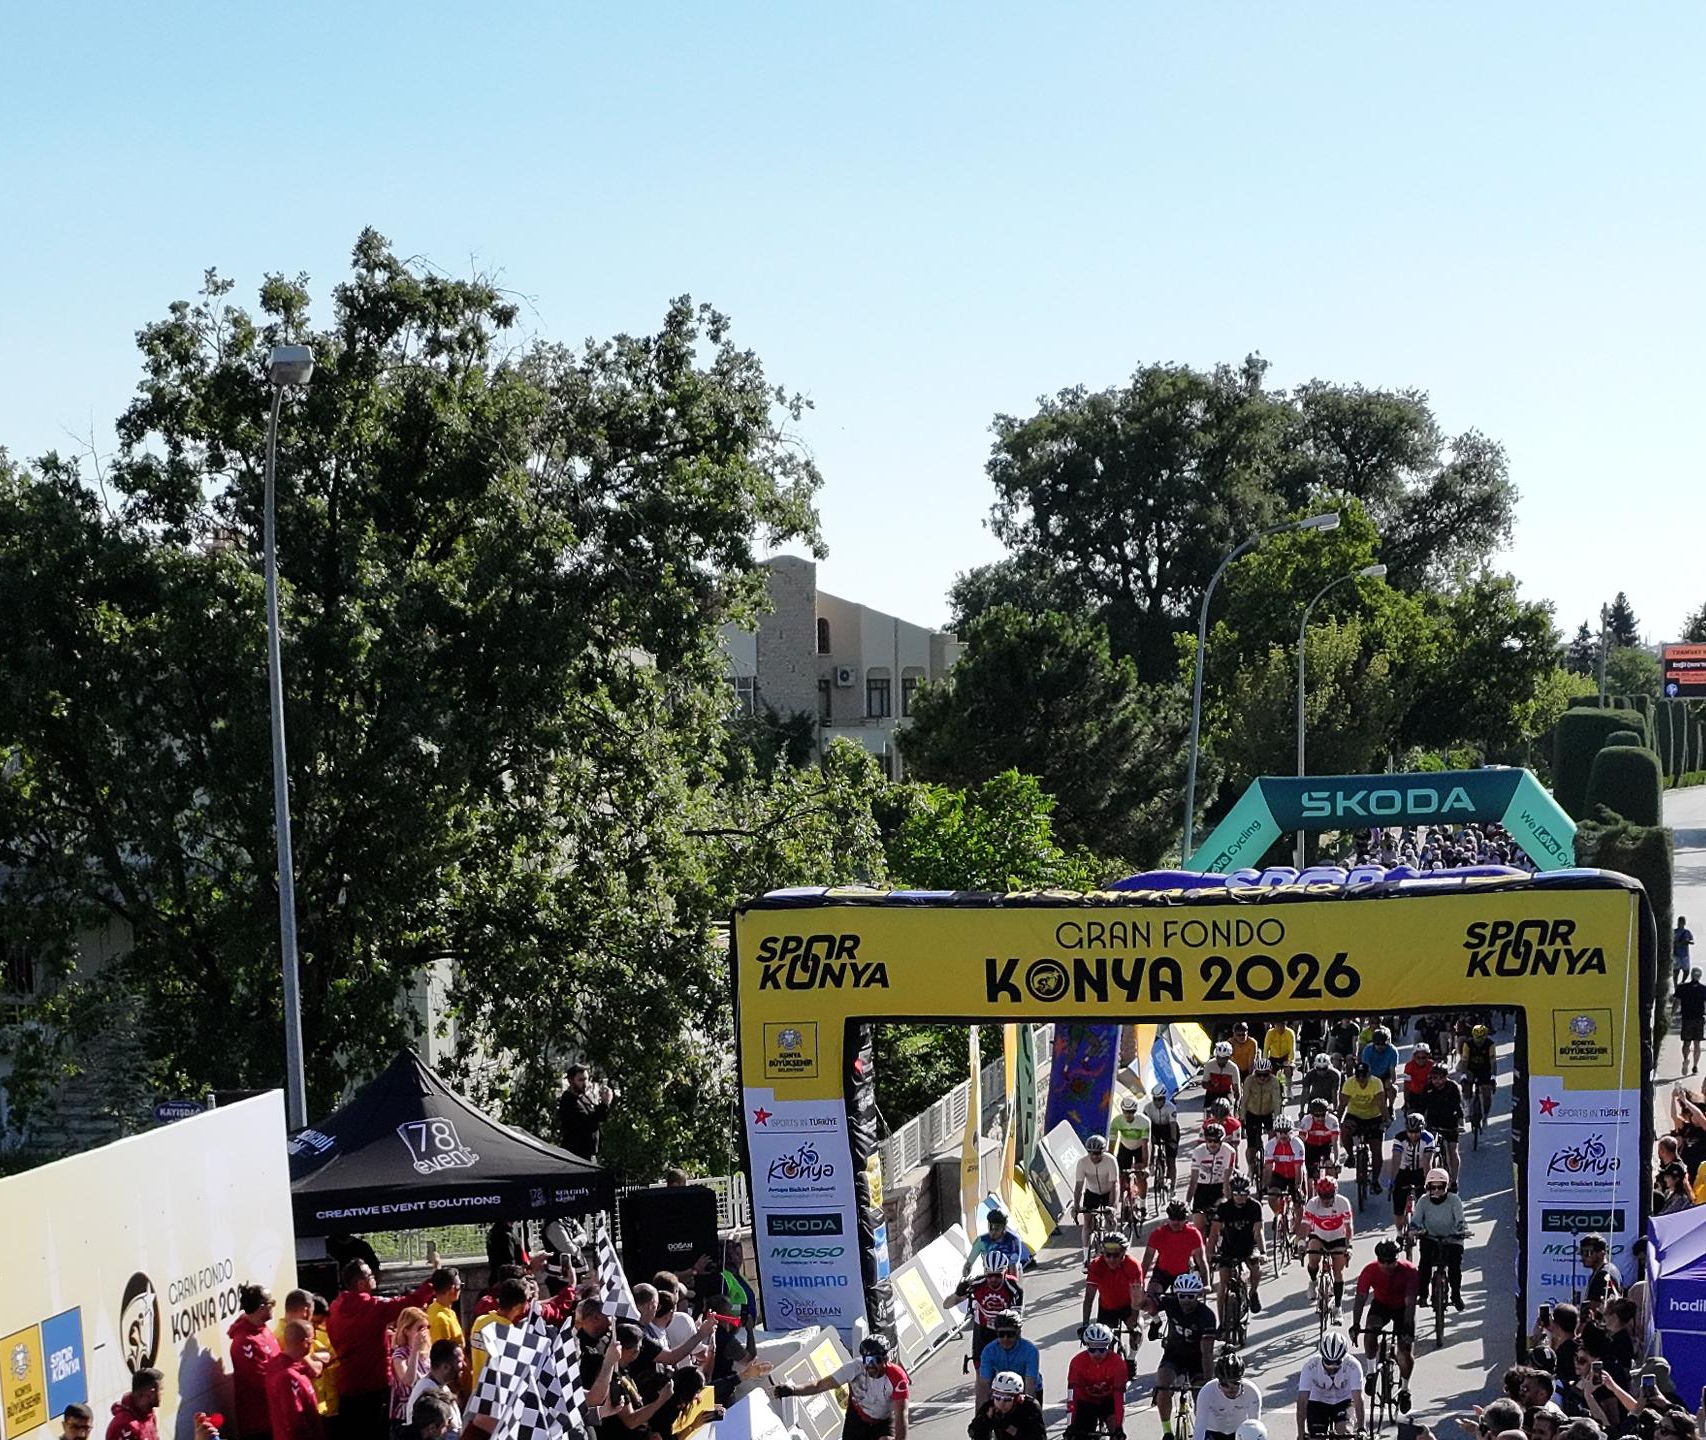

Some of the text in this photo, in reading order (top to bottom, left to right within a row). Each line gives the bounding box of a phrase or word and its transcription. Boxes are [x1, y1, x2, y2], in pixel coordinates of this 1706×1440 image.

[1227, 820, 1261, 855] Cycling
[757, 934, 861, 962] SPOR
[1056, 918, 1285, 950] GRAN FONDO
[1463, 920, 1576, 949] SPOR
[759, 961, 890, 991] KONYA
[1465, 948, 1606, 977] KONYA
[985, 952, 1362, 1003] KONYA 2026
[408, 1122, 456, 1153] 78
[414, 1147, 479, 1173] event
[316, 1195, 501, 1219] CREATIVE EVENT SOLUTIONS
[770, 1247, 845, 1258] MOSSO
[1543, 1245, 1625, 1255] MOO
[168, 1258, 233, 1306] GRAN FONDO
[773, 1275, 848, 1287] SHIMANO
[170, 1299, 217, 1344] KONYA
[795, 1307, 841, 1316] DEDEMAN
